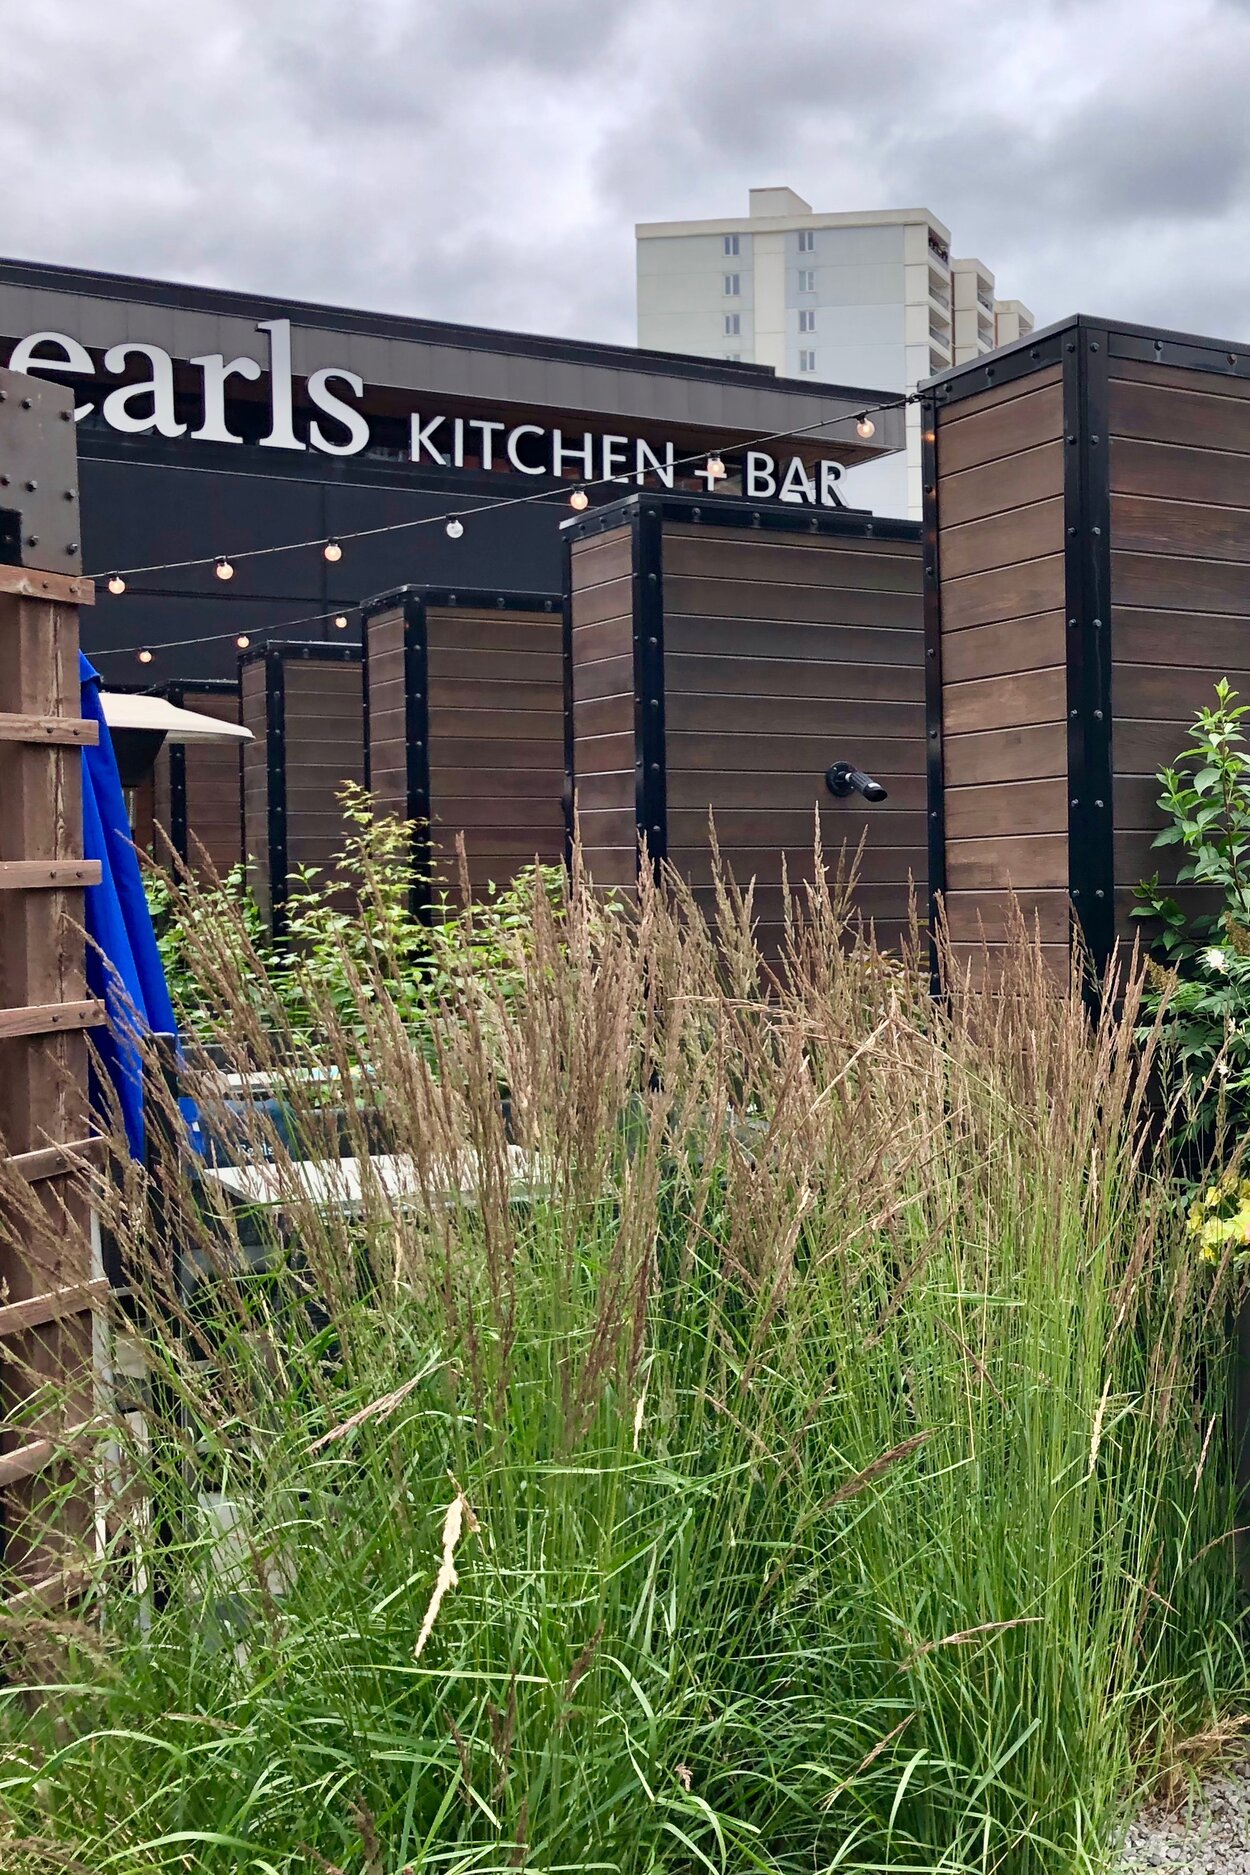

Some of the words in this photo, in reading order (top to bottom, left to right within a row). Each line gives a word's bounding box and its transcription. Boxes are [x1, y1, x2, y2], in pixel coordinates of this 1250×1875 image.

[9, 319, 370, 456] earls
[409, 412, 674, 488] KITCHEN
[746, 451, 849, 507] BAR
